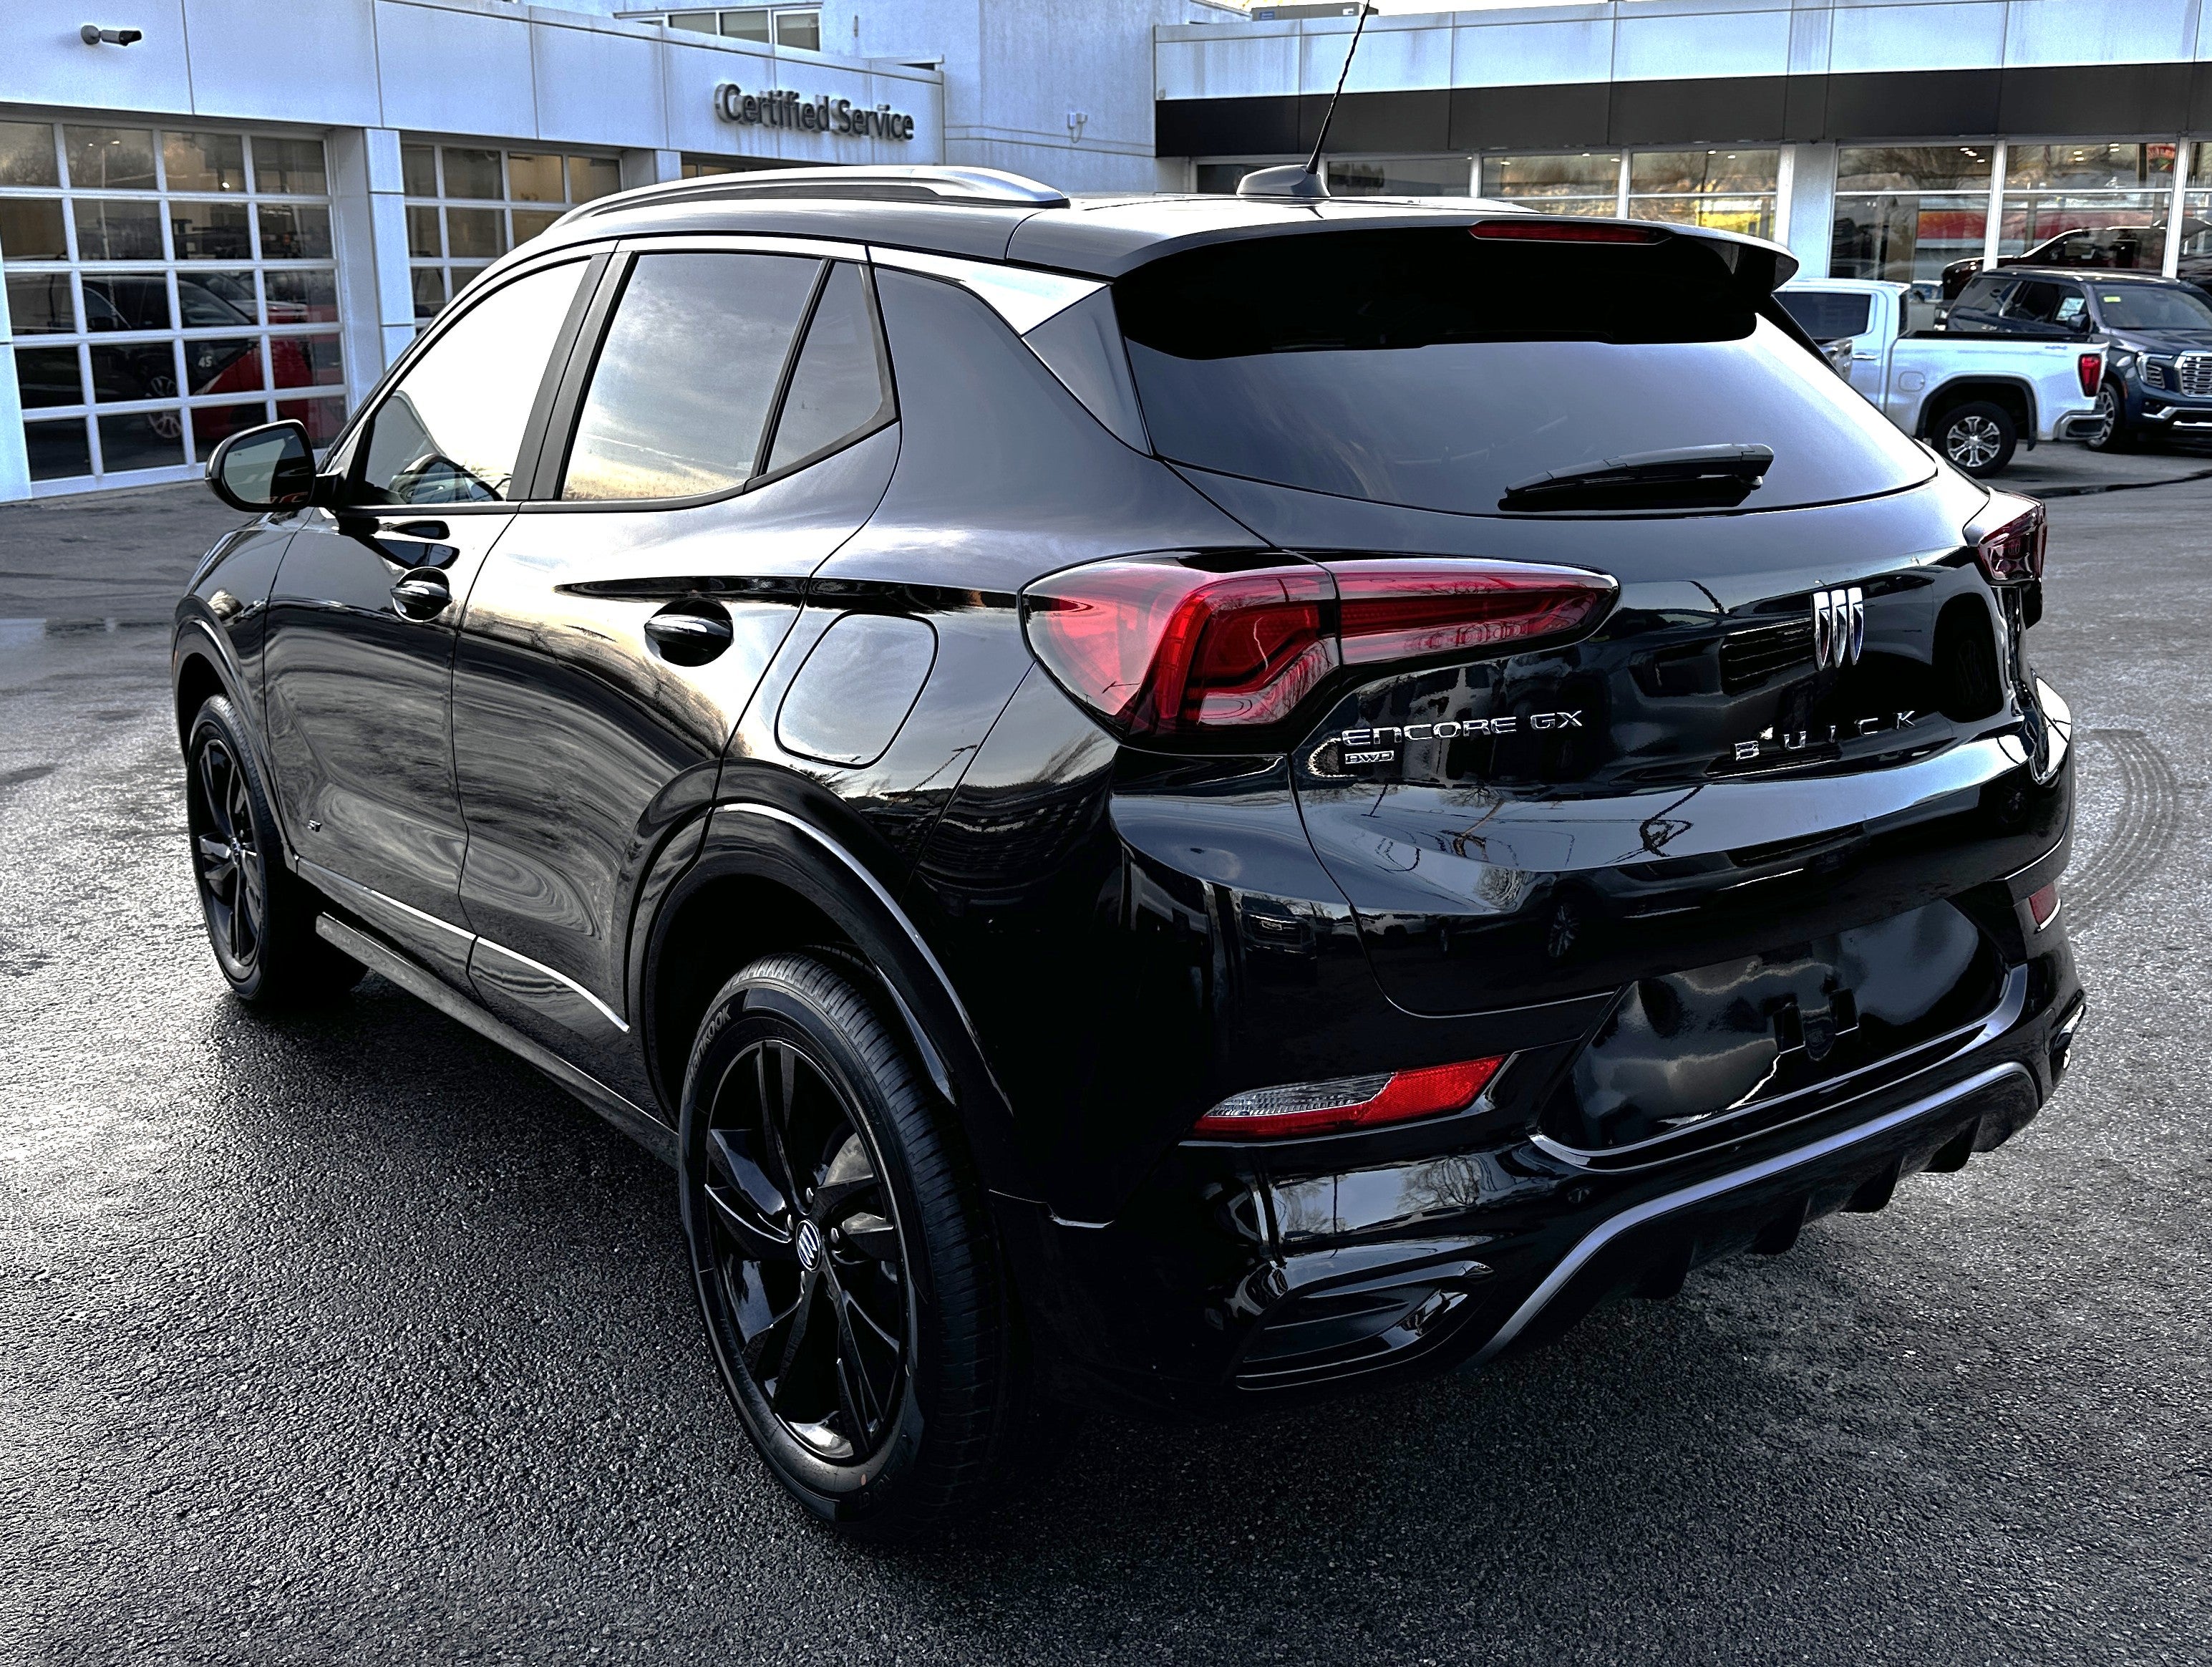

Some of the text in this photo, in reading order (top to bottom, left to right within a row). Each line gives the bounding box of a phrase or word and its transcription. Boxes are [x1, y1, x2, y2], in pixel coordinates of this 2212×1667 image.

[715, 84, 914, 141] Certified Service
[1342, 710, 1583, 746] ENCORE GX
[1731, 710, 1915, 761] BUICK
